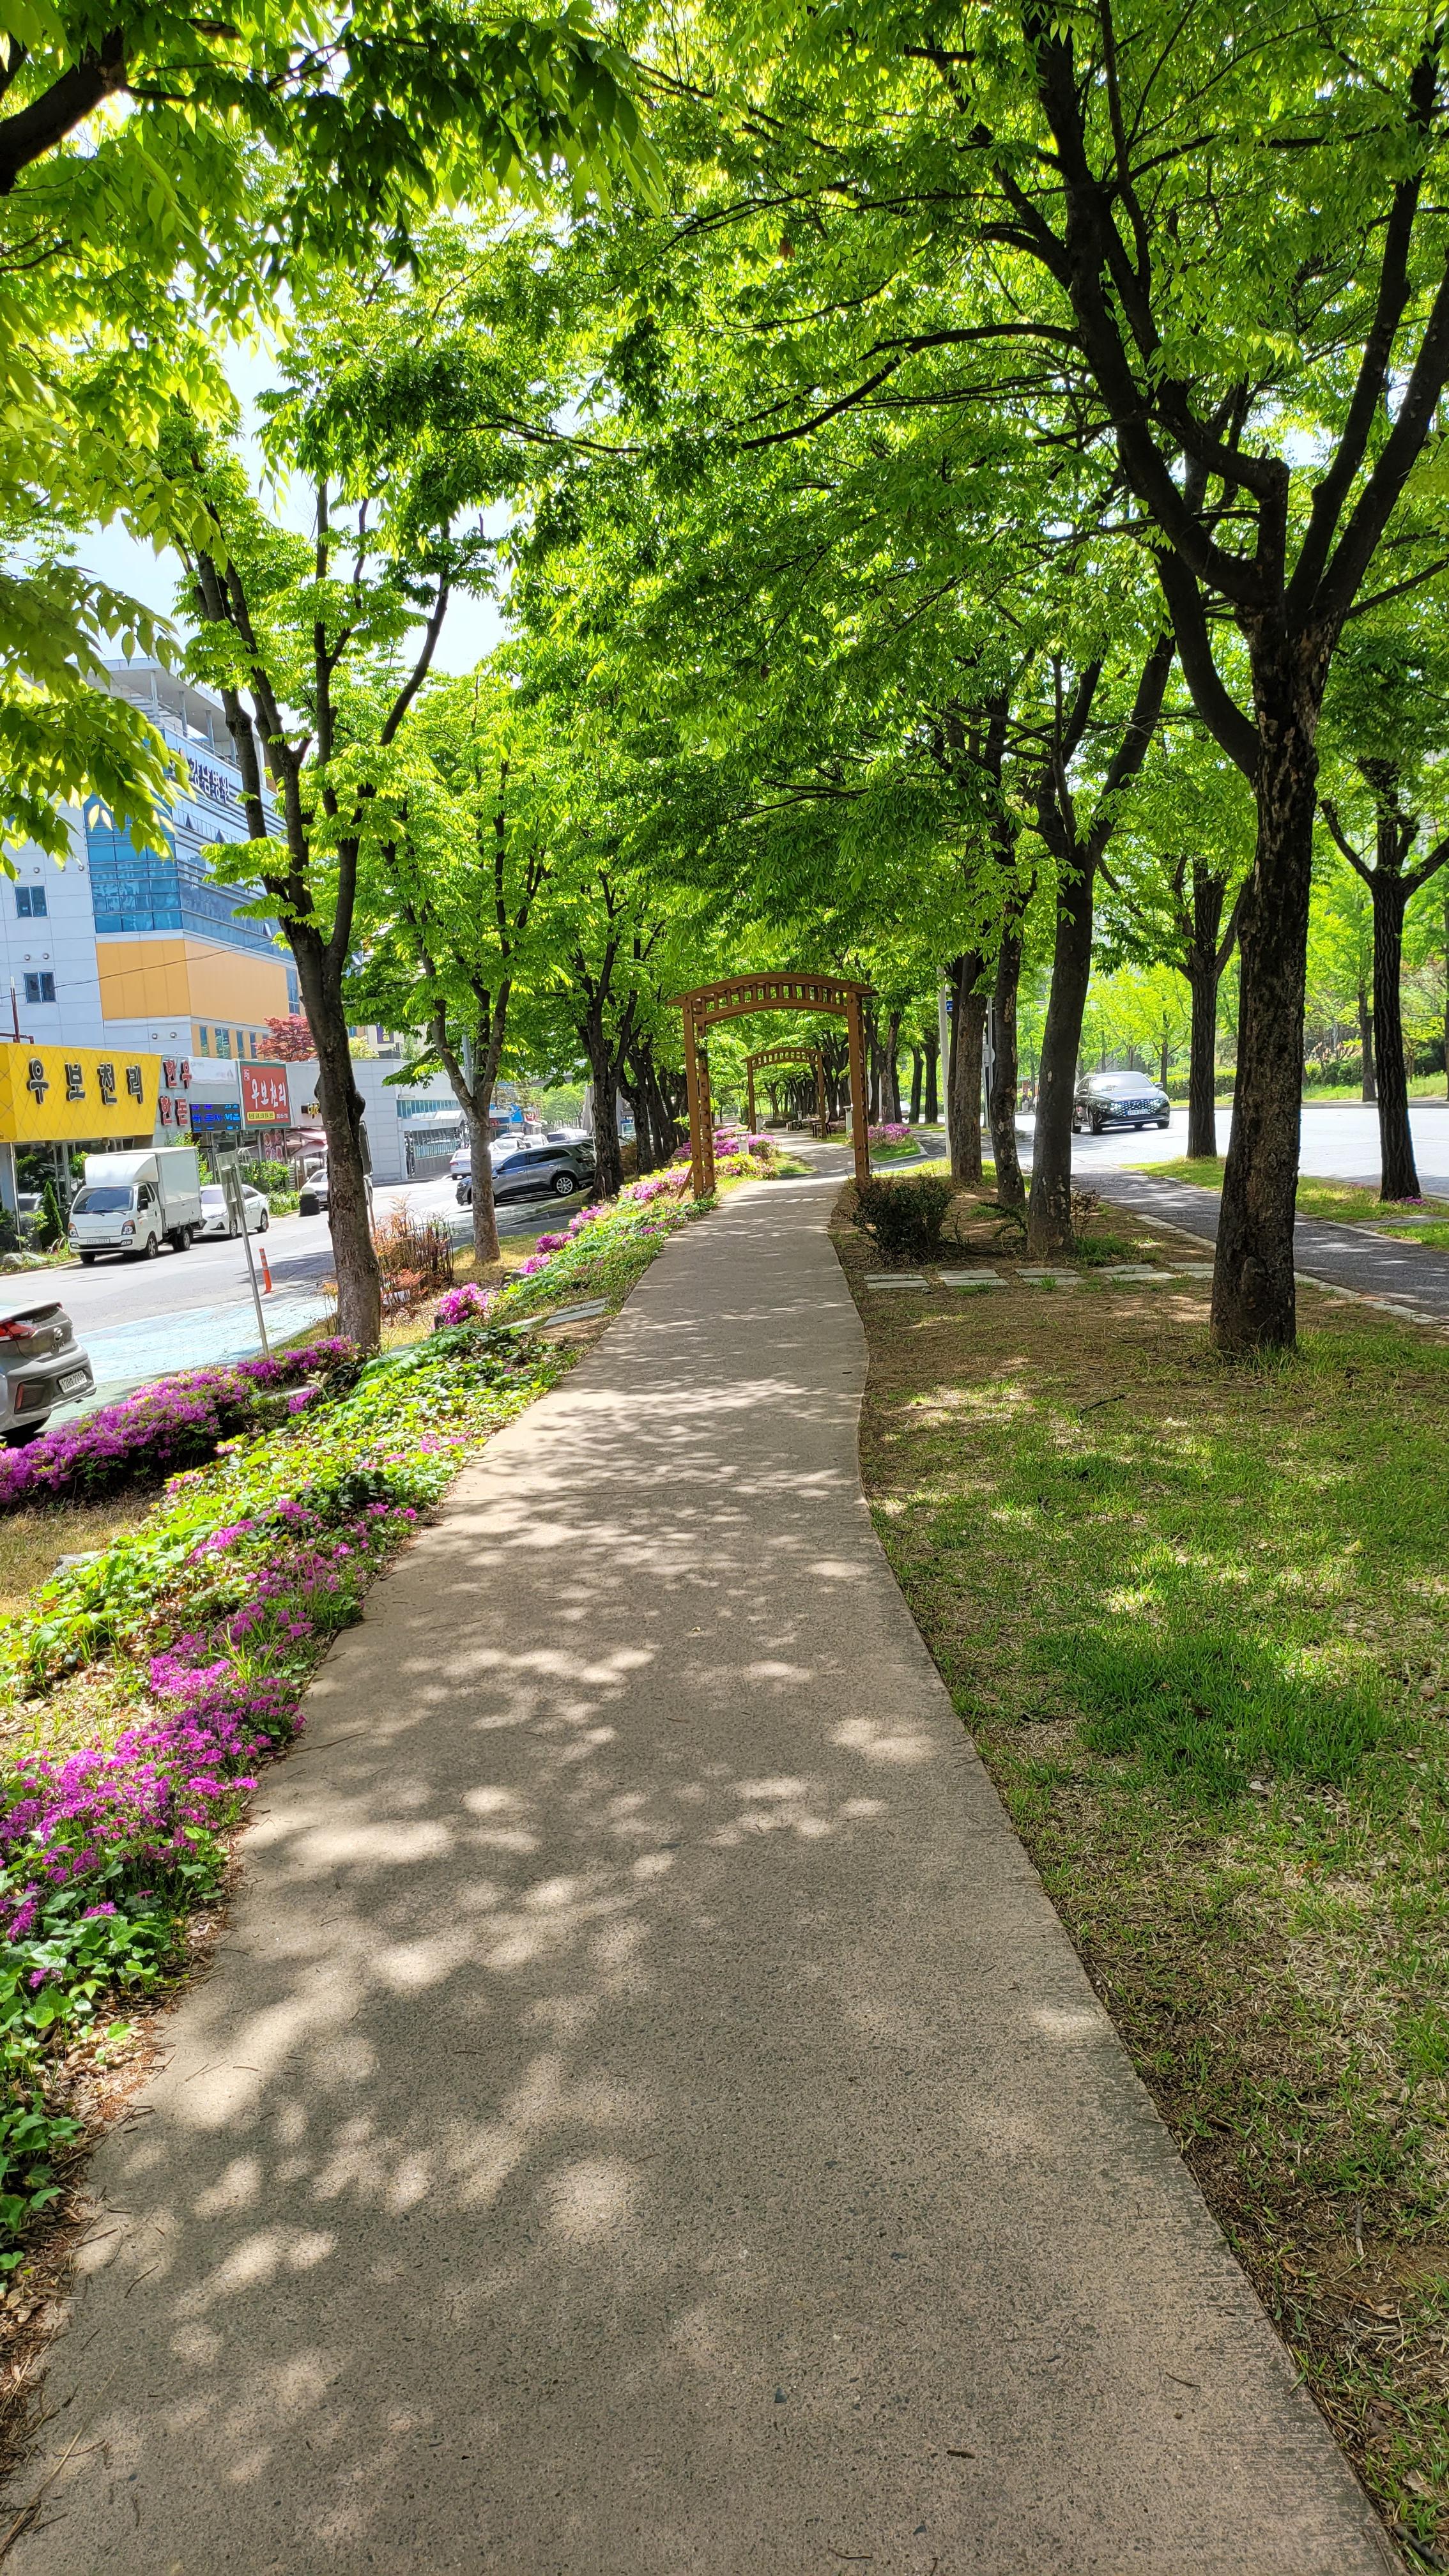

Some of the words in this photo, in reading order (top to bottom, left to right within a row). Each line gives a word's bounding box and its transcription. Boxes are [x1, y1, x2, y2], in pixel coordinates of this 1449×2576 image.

[27, 1057, 143, 1105] 우보천리
[163, 1059, 192, 1089] 한우
[251, 1078, 286, 1110] 우보천리
[158, 1096, 188, 1126] 한돈
